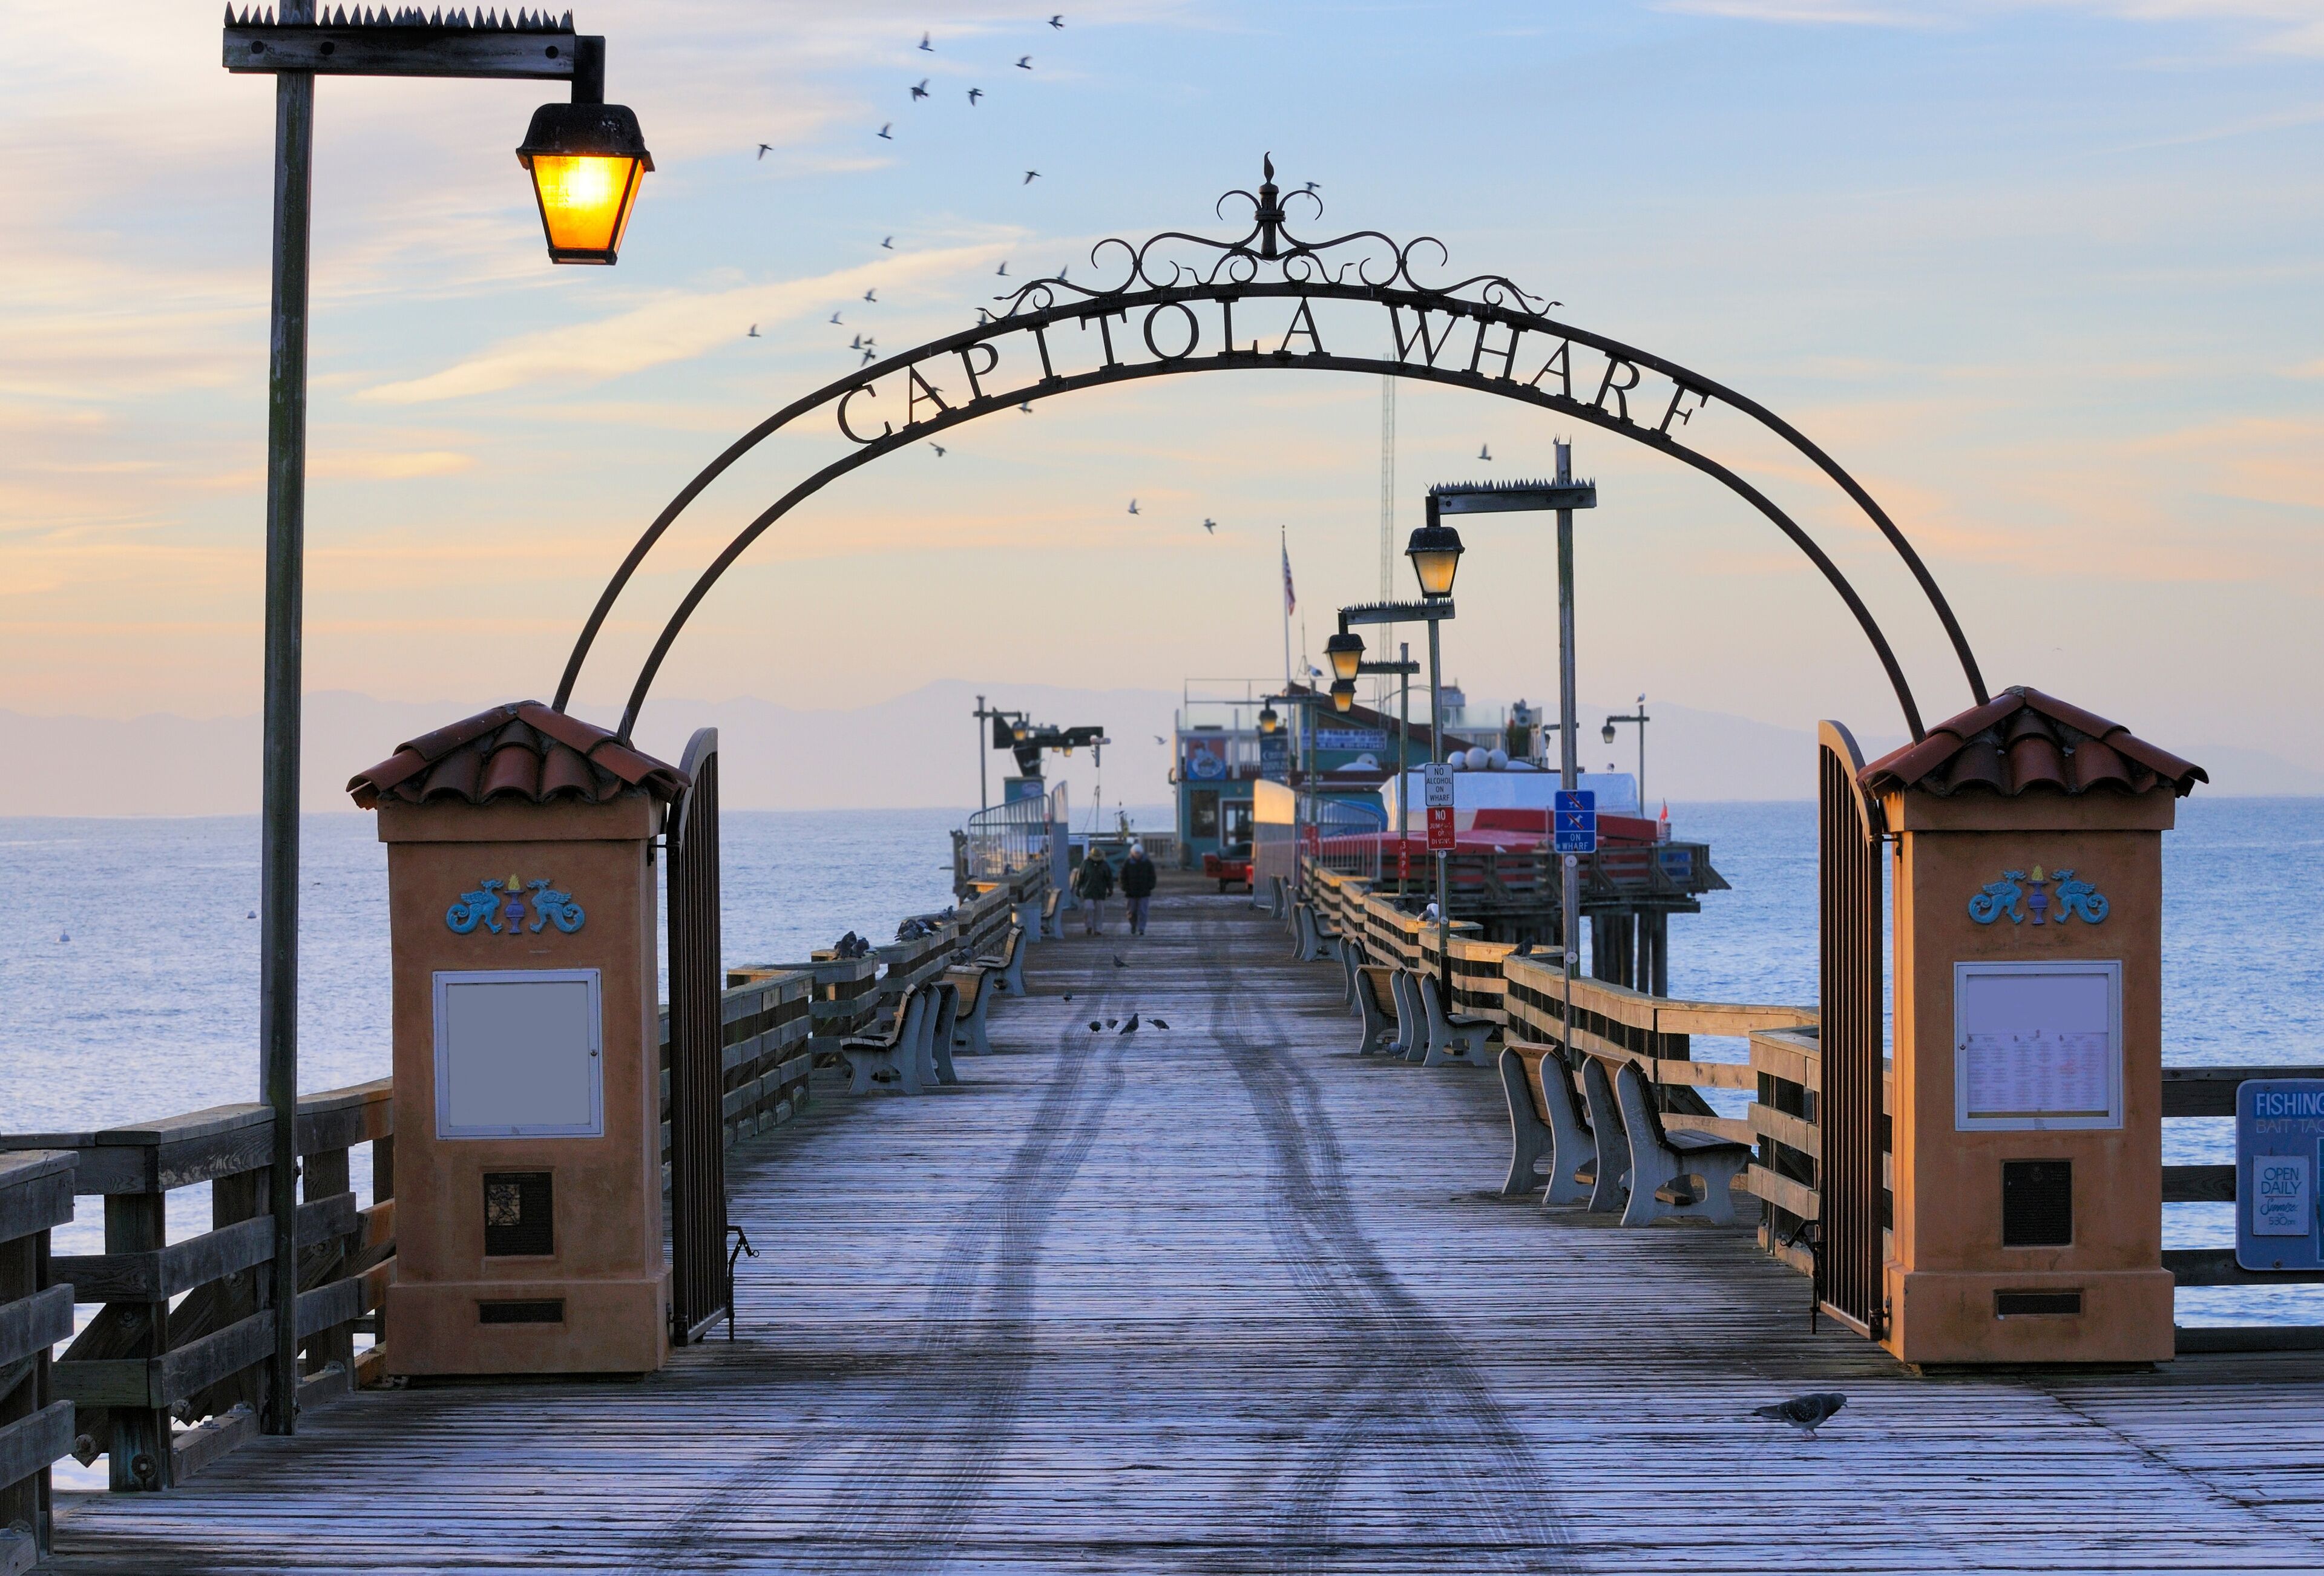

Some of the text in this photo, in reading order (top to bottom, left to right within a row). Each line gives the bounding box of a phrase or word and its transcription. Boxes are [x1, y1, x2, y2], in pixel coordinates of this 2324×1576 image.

[837, 297, 1712, 444] CAPITOLA WHARF
[1435, 810, 1446, 820] NO
[2256, 1092, 2324, 1115] FISHING
[2256, 1119, 2292, 1134] BAIT
[2264, 1167, 2299, 1181] OPEN
[2261, 1181, 2302, 1195] DAILY
[2260, 1198, 2299, 1215] Sunrise
